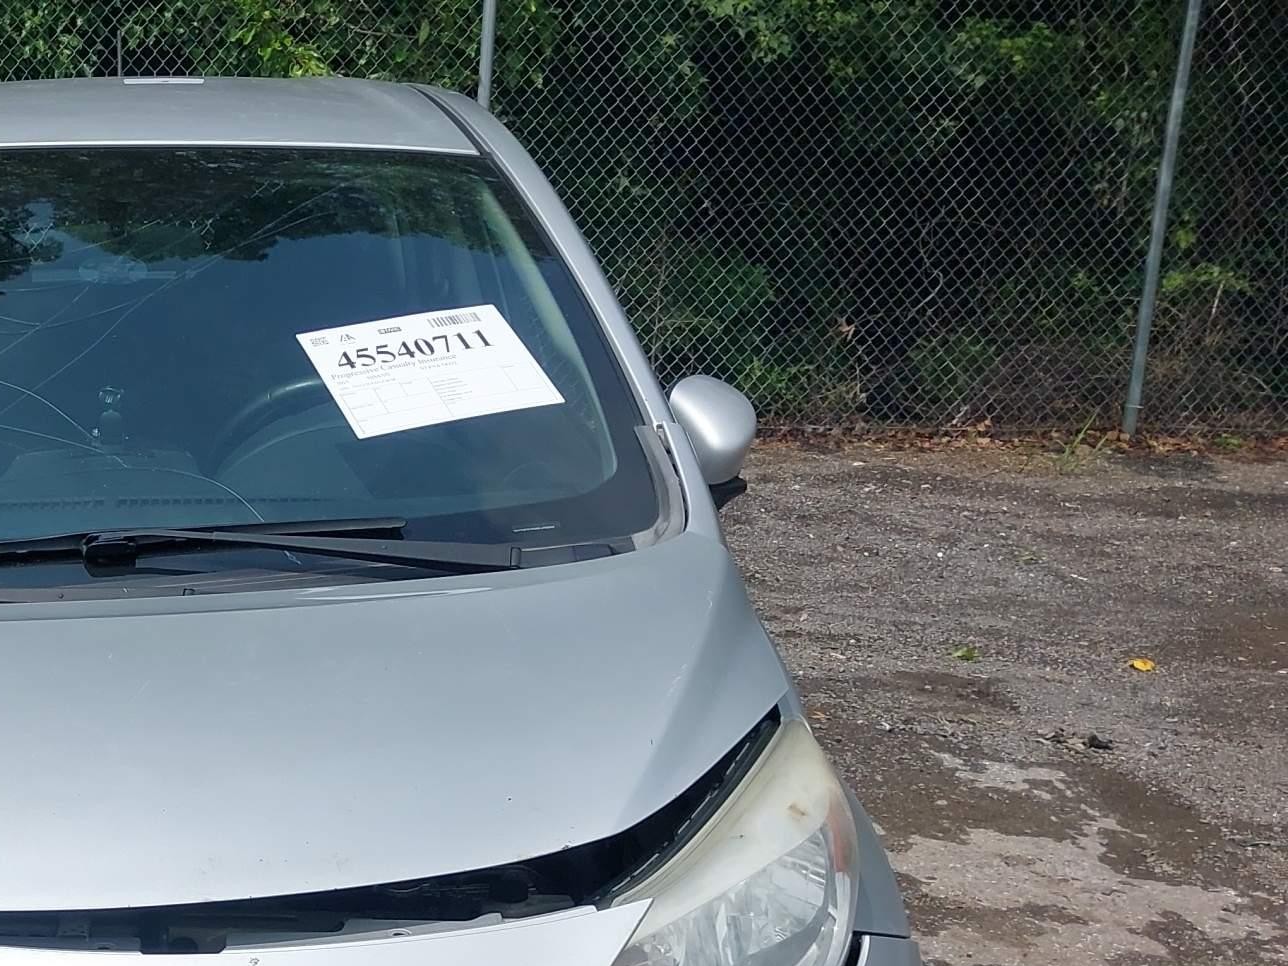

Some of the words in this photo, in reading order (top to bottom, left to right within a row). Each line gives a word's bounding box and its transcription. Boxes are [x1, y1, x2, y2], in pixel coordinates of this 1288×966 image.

[337, 329, 495, 369] 45540711
[330, 367, 380, 380] Progressive
[380, 359, 416, 371] Casualty
[418, 354, 457, 365] Insurance
